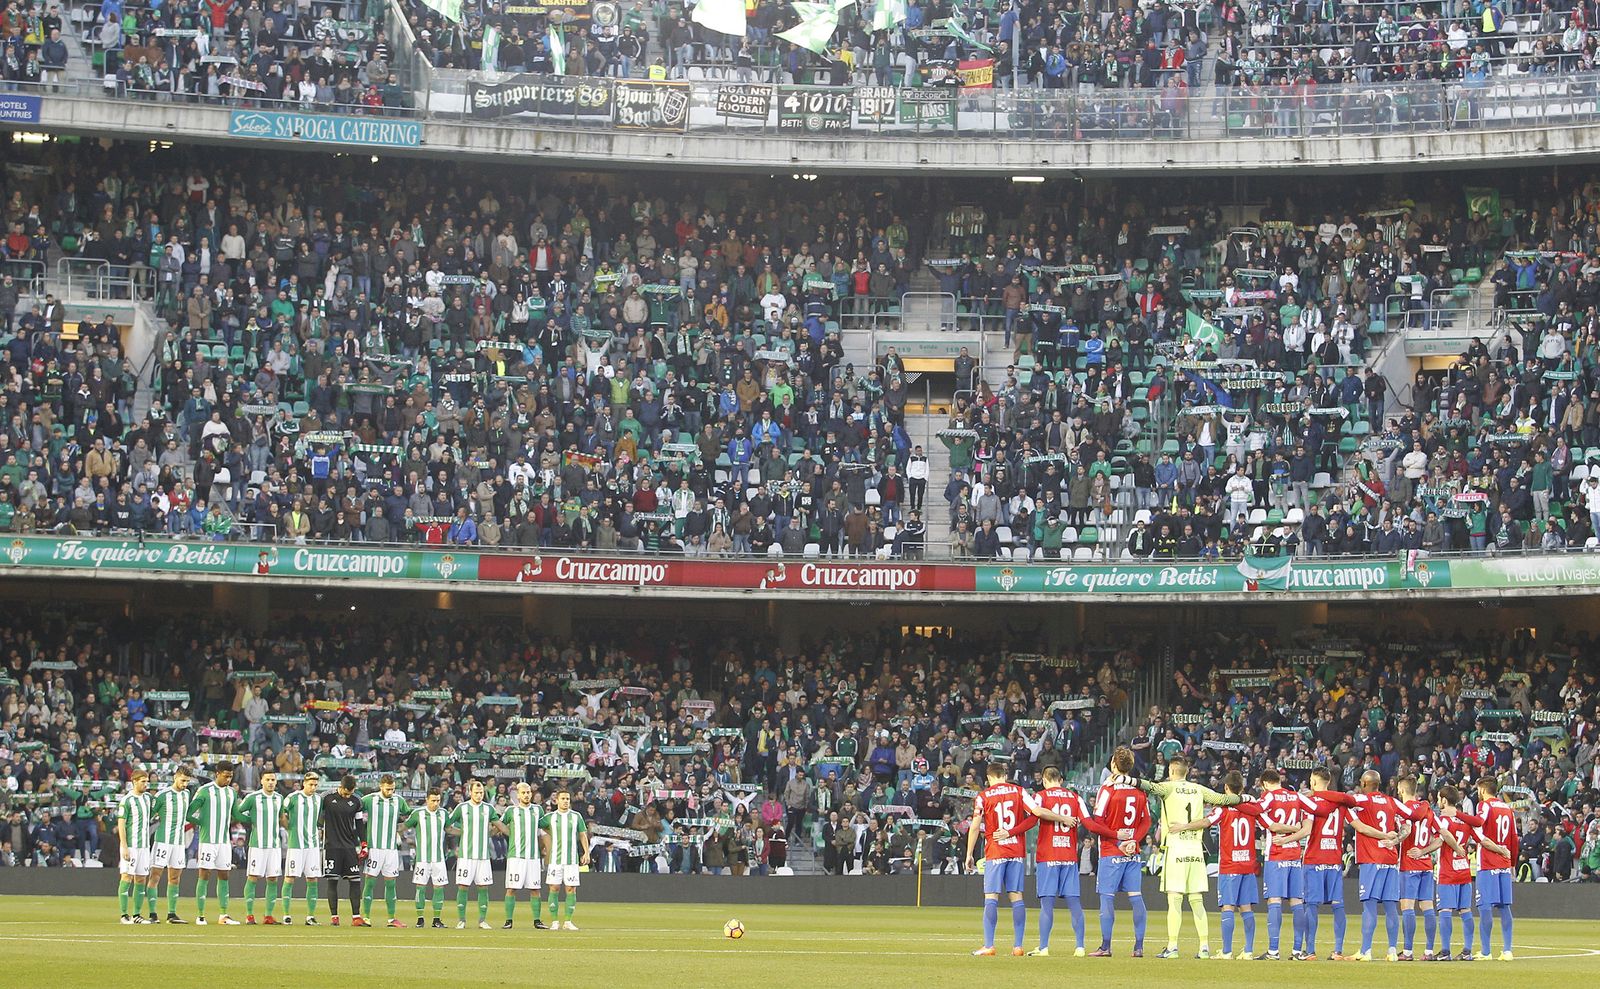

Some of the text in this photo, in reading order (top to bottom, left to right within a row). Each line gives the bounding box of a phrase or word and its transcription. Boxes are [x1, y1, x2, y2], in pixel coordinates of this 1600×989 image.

[474, 86, 576, 108] Supporters
[720, 86, 772, 97] AGANST
[783, 91, 847, 114] 41010
[860, 87, 896, 99] GRADA
[718, 102, 768, 114] FOOTBAL
[860, 99, 893, 116] 1907
[275, 116, 418, 146] SABOGA CATERING
[445, 373, 471, 383] BETIS
[53, 540, 230, 568] ¡Te quiero Betis!
[294, 548, 403, 577] Cruzcampo
[555, 557, 665, 583] Cruzcampo
[801, 563, 916, 588] Cruzcampo
[1044, 567, 1218, 593] ¡Te quiero Betis!
[994, 800, 1016, 831] 15
[1124, 796, 1136, 827] 5
[1185, 802, 1192, 824] 1
[1274, 808, 1298, 833] 24
[1322, 808, 1339, 836] 21
[1232, 817, 1250, 847] 10
[1376, 811, 1387, 835] 3
[1414, 818, 1429, 847] 16
[1495, 814, 1510, 843] 19
[156, 849, 167, 859] 12
[200, 852, 211, 862] 15
[251, 859, 256, 868] 4
[290, 860, 296, 869] 8
[323, 860, 335, 869] 13
[367, 858, 378, 869] 20
[415, 868, 425, 877] 24
[458, 869, 469, 878] 18
[509, 873, 520, 882] 10
